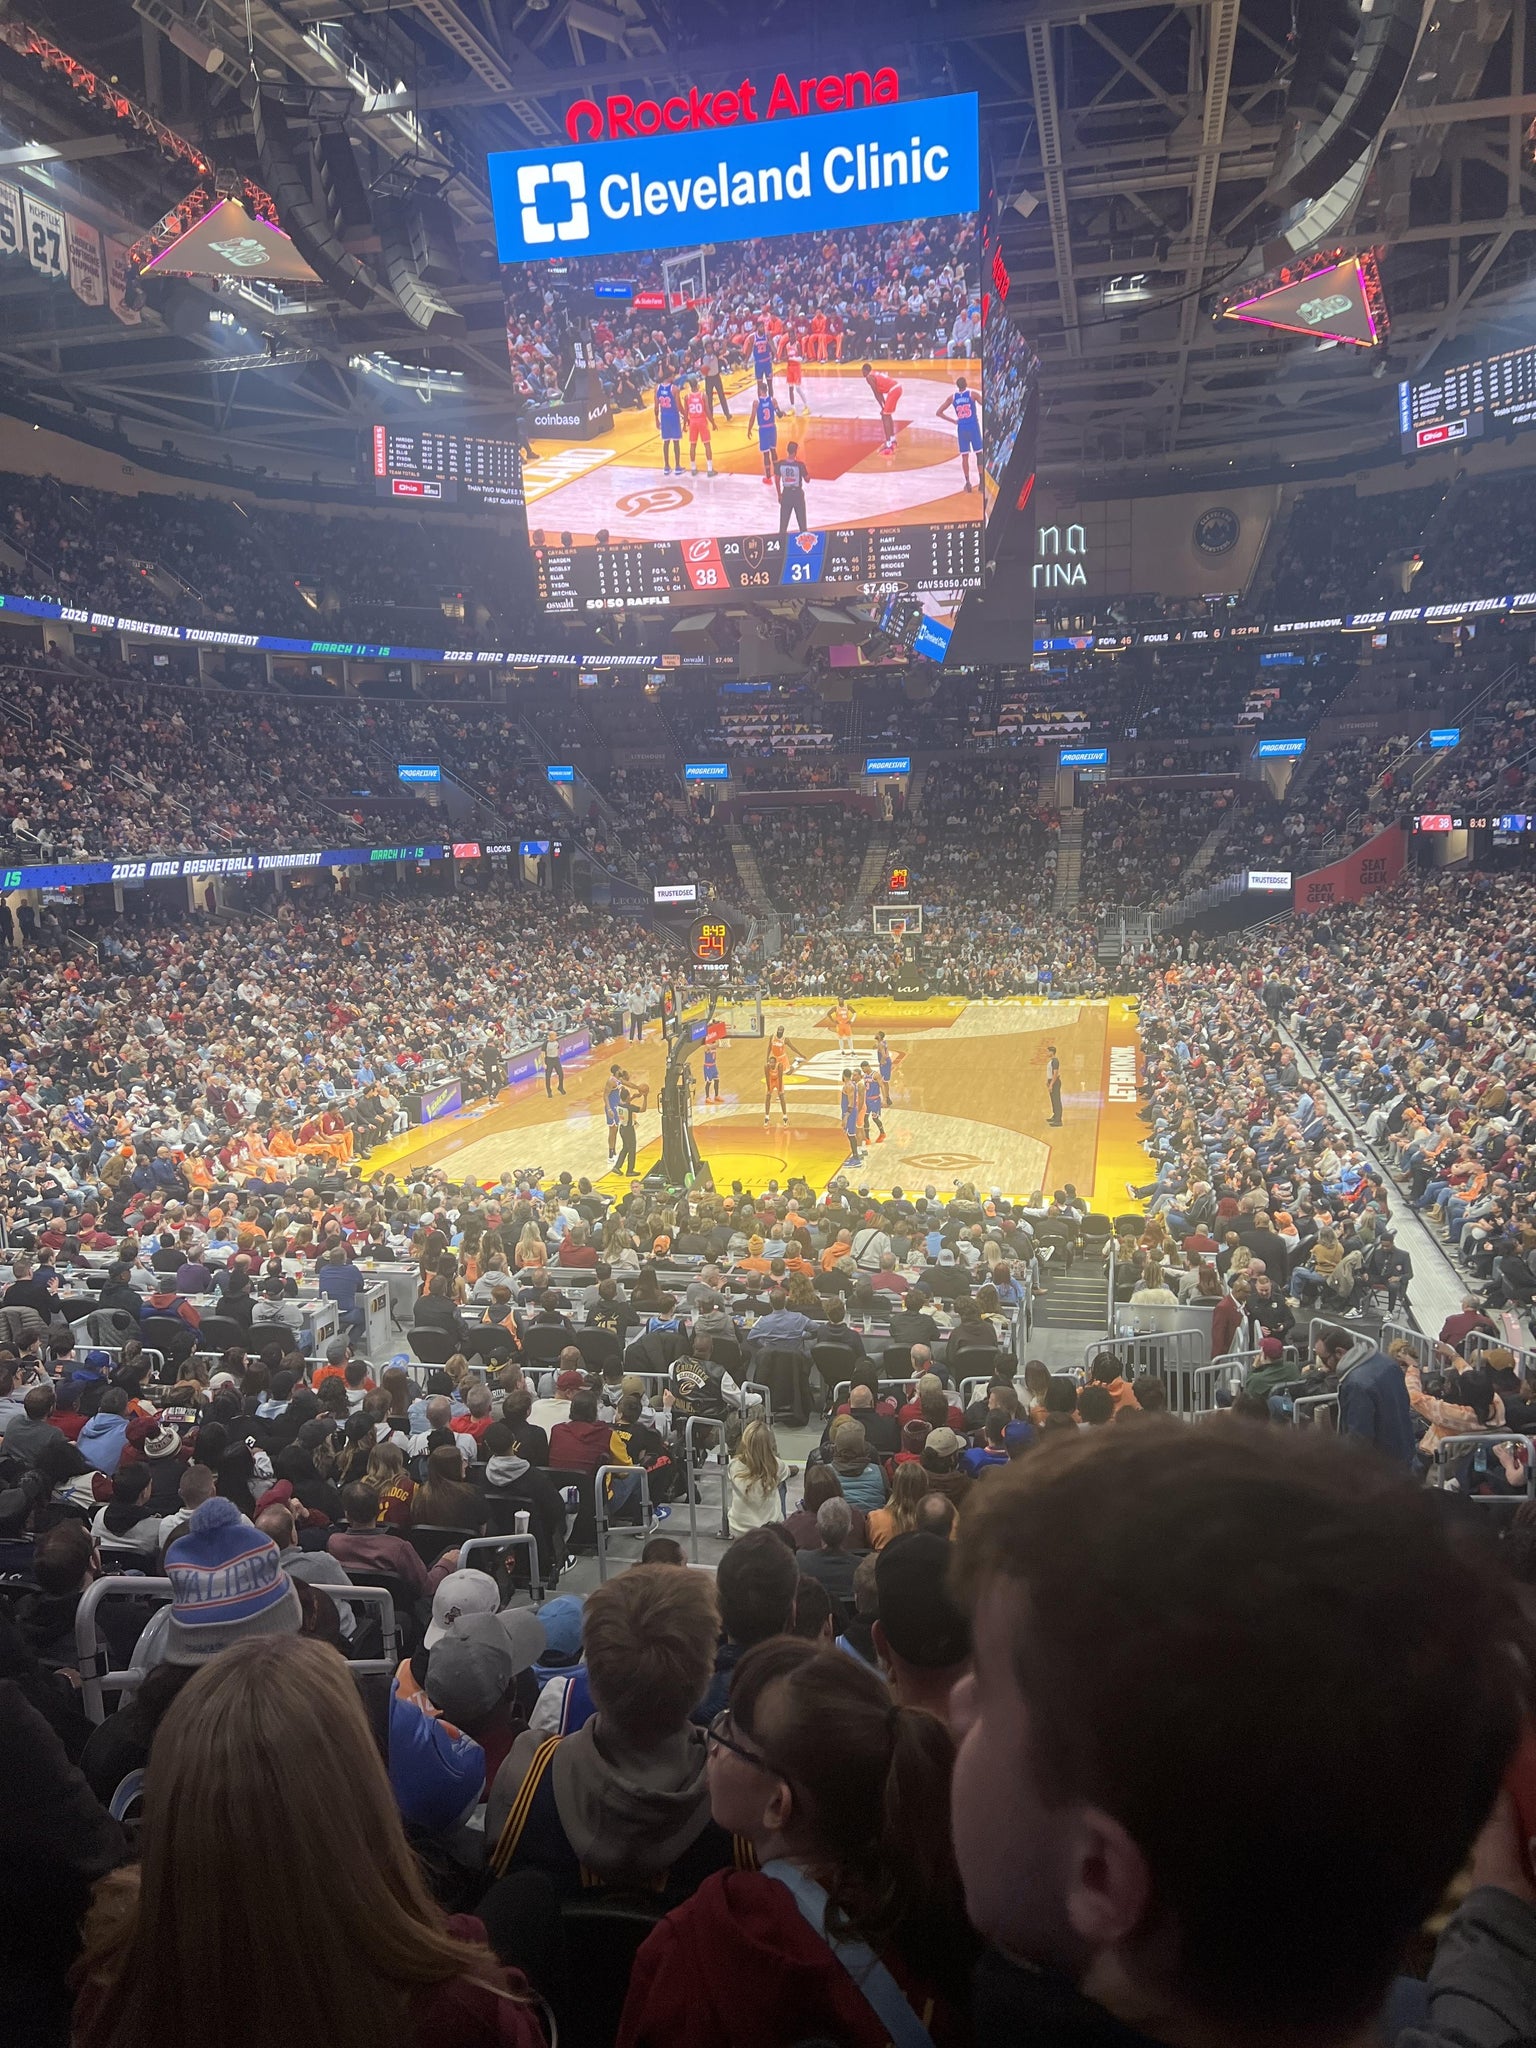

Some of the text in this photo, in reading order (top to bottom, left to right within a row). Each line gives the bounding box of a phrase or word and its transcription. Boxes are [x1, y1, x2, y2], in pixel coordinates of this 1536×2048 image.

[607, 66, 900, 138] Rocket Arena
[598, 136, 950, 221] Cleveland Clinic
[32, 222, 60, 271] 27
[689, 404, 702, 413] 20
[762, 408, 770, 420] 3
[957, 404, 971, 418] 25
[535, 414, 580, 425] coinbase
[1423, 432, 1442, 441] Ohio
[1200, 511, 1232, 525] CLEVELAND
[724, 543, 740, 554] 2Q
[767, 541, 780, 551] 24
[1200, 540, 1230, 551] MONSTERS
[696, 568, 717, 586] 38
[791, 563, 810, 580] 31
[740, 572, 769, 586] 8:43
[863, 578, 981, 595] $7,496 CAVS5050.COM
[546, 598, 574, 609] oswald
[626, 596, 670, 606] RAFFLE
[1352, 612, 1386, 626] 2026
[1389, 608, 1420, 621] MAC
[1424, 597, 1507, 617] BASKETBALL
[1273, 624, 1293, 632] LET
[1294, 622, 1309, 630] EM
[60, 608, 88, 622] 2026
[91, 613, 114, 627] MAC
[117, 618, 181, 638] BASKETBALL
[185, 629, 259, 646] TOURNAMENT
[311, 643, 352, 654] MARCH
[357, 645, 365, 654] 11
[379, 647, 390, 656] 15
[444, 651, 473, 661] 2026
[477, 652, 503, 662] MAC
[507, 653, 577, 665] BASKETBALL
[582, 656, 658, 665] TOURNAMENT
[1121, 637, 1132, 645] 46
[1144, 634, 1168, 642] FOULS
[1175, 632, 1181, 641] 4
[1192, 630, 1208, 639] TOL
[1214, 630, 1220, 638] 6
[1231, 627, 1246, 636] 8:22
[1248, 626, 1259, 634] PM
[1062, 752, 1105, 761] PROGRESSIVE
[868, 761, 908, 770] PROGRESSIVE
[400, 769, 438, 777] PROGRESSIVE
[1439, 818, 1449, 827] 38
[1470, 818, 1486, 828] 8:43
[1492, 818, 1500, 827] 24
[1503, 817, 1511, 828] 31
[4, 848, 424, 887] 15 2026 MAC BASKETBALL TOURNAMENT MARCH 11 15
[1362, 858, 1387, 871] SEAT
[891, 876, 906, 888] 24
[1360, 871, 1387, 884] GEEK
[1309, 884, 1334, 892] SEAT
[1307, 893, 1335, 902] GEEK
[703, 925, 725, 936] 8:43
[699, 937, 724, 956] 24
[676, 1362, 709, 1381] Cavaliers
[680, 1372, 702, 1384] CLEVELAND
